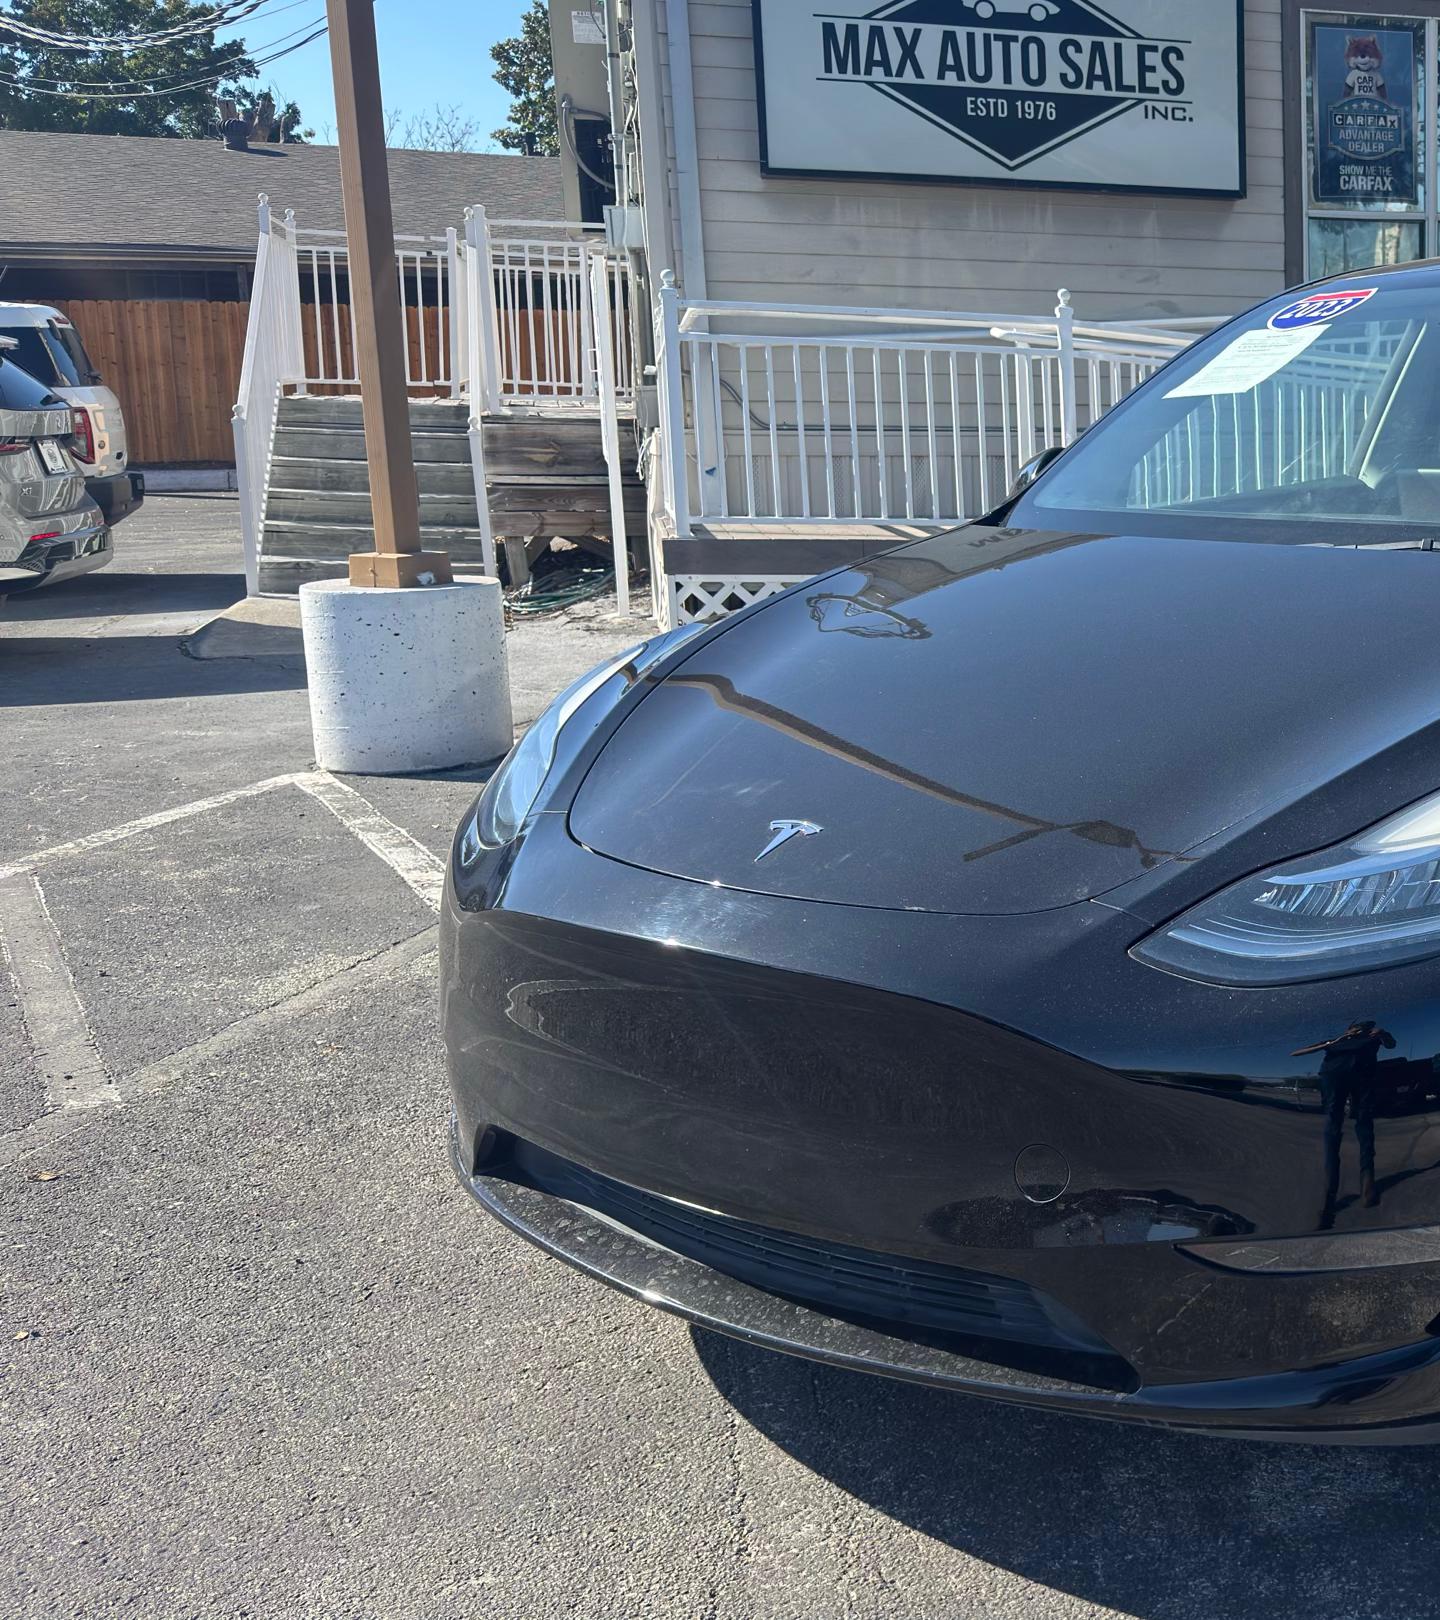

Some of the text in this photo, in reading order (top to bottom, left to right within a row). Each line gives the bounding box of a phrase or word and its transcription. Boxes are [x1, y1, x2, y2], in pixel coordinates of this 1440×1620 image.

[822, 22, 1186, 97] MAX AUTO SALES
[1356, 76, 1374, 85] CAR
[1358, 85, 1374, 93] FOX
[966, 97, 1057, 121] ESTD 1976
[1143, 104, 1194, 123] INC.
[1334, 114, 1397, 128] CARFAX
[1339, 128, 1394, 142] ADVANTAGE
[1348, 141, 1384, 153] DEALER
[1339, 165, 1393, 176] SHOW ME THE
[1340, 175, 1393, 191] CARFAX
[1277, 298, 1353, 319] 2023
